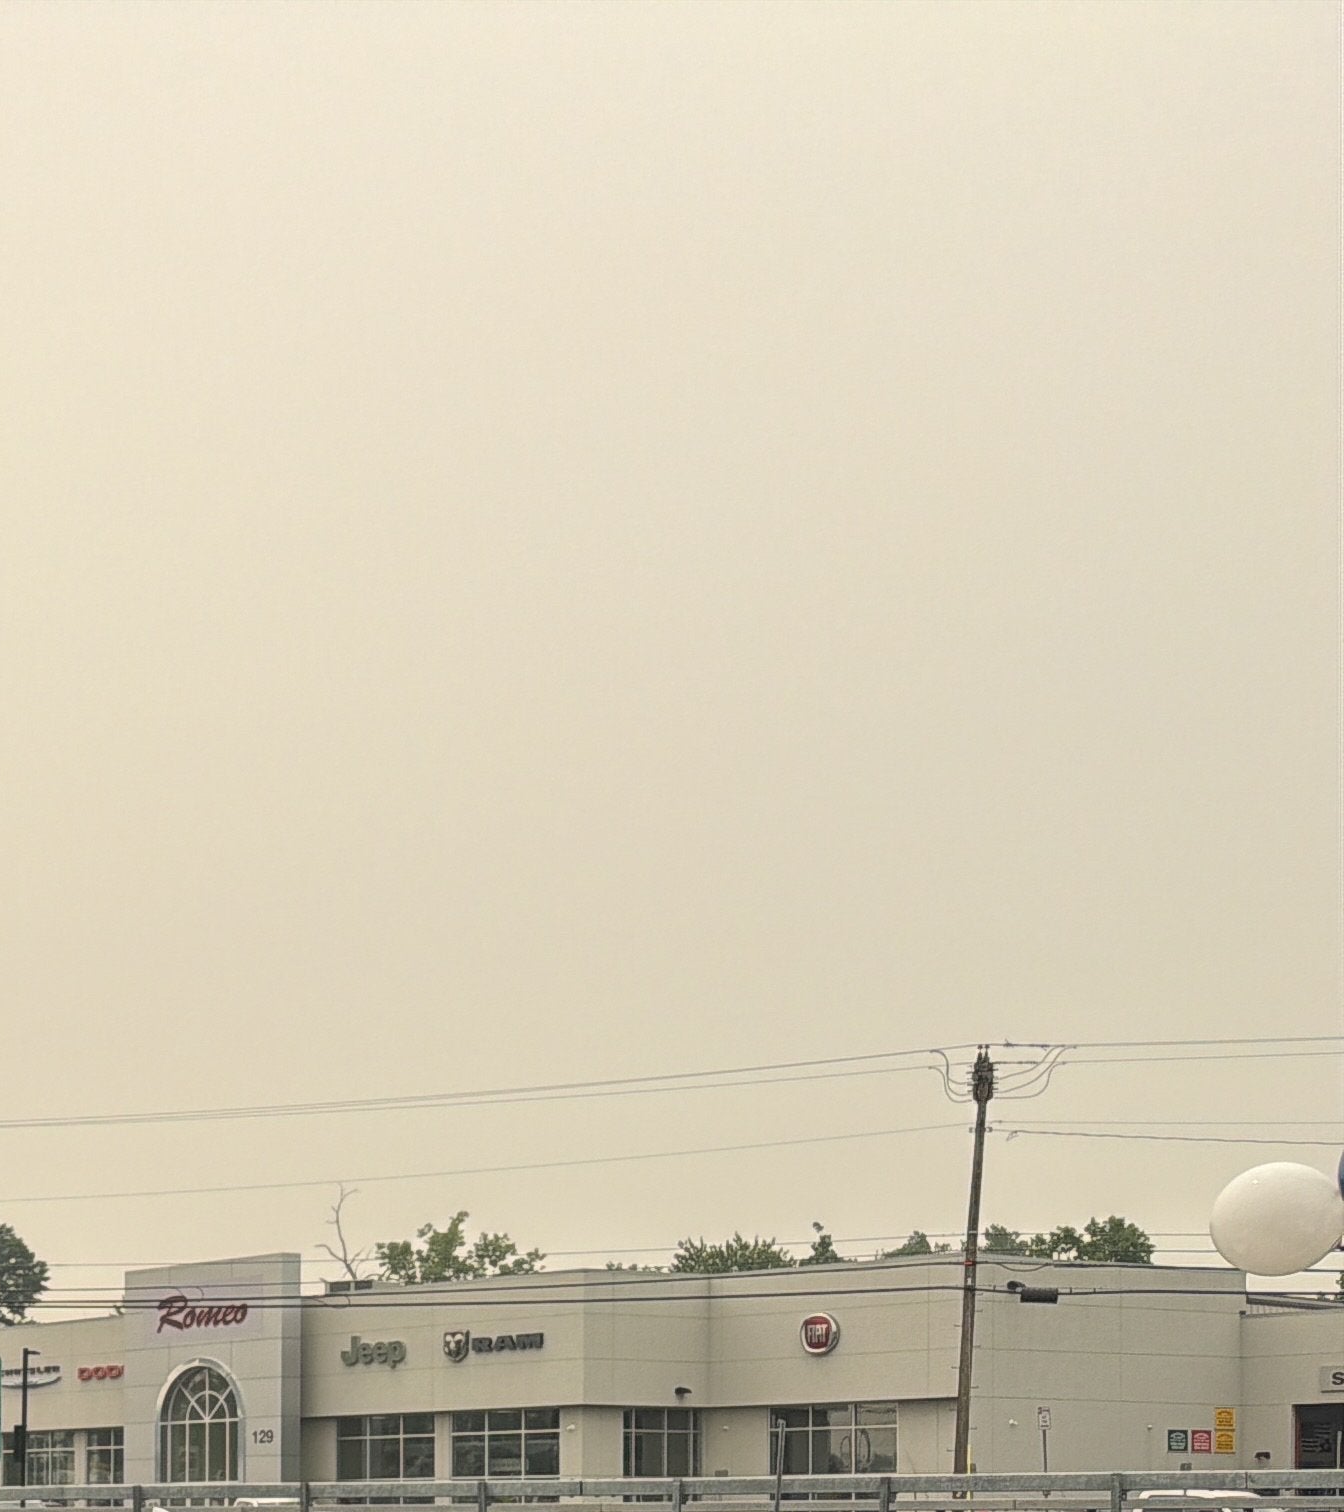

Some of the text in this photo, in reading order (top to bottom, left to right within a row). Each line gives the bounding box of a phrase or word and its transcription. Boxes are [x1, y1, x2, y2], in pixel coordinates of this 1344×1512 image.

[156, 1295, 248, 1334] Romeo
[471, 1332, 544, 1353] RAM
[807, 1324, 828, 1344] FIAT
[341, 1336, 406, 1369] Jeep
[252, 1430, 274, 1444] 129
